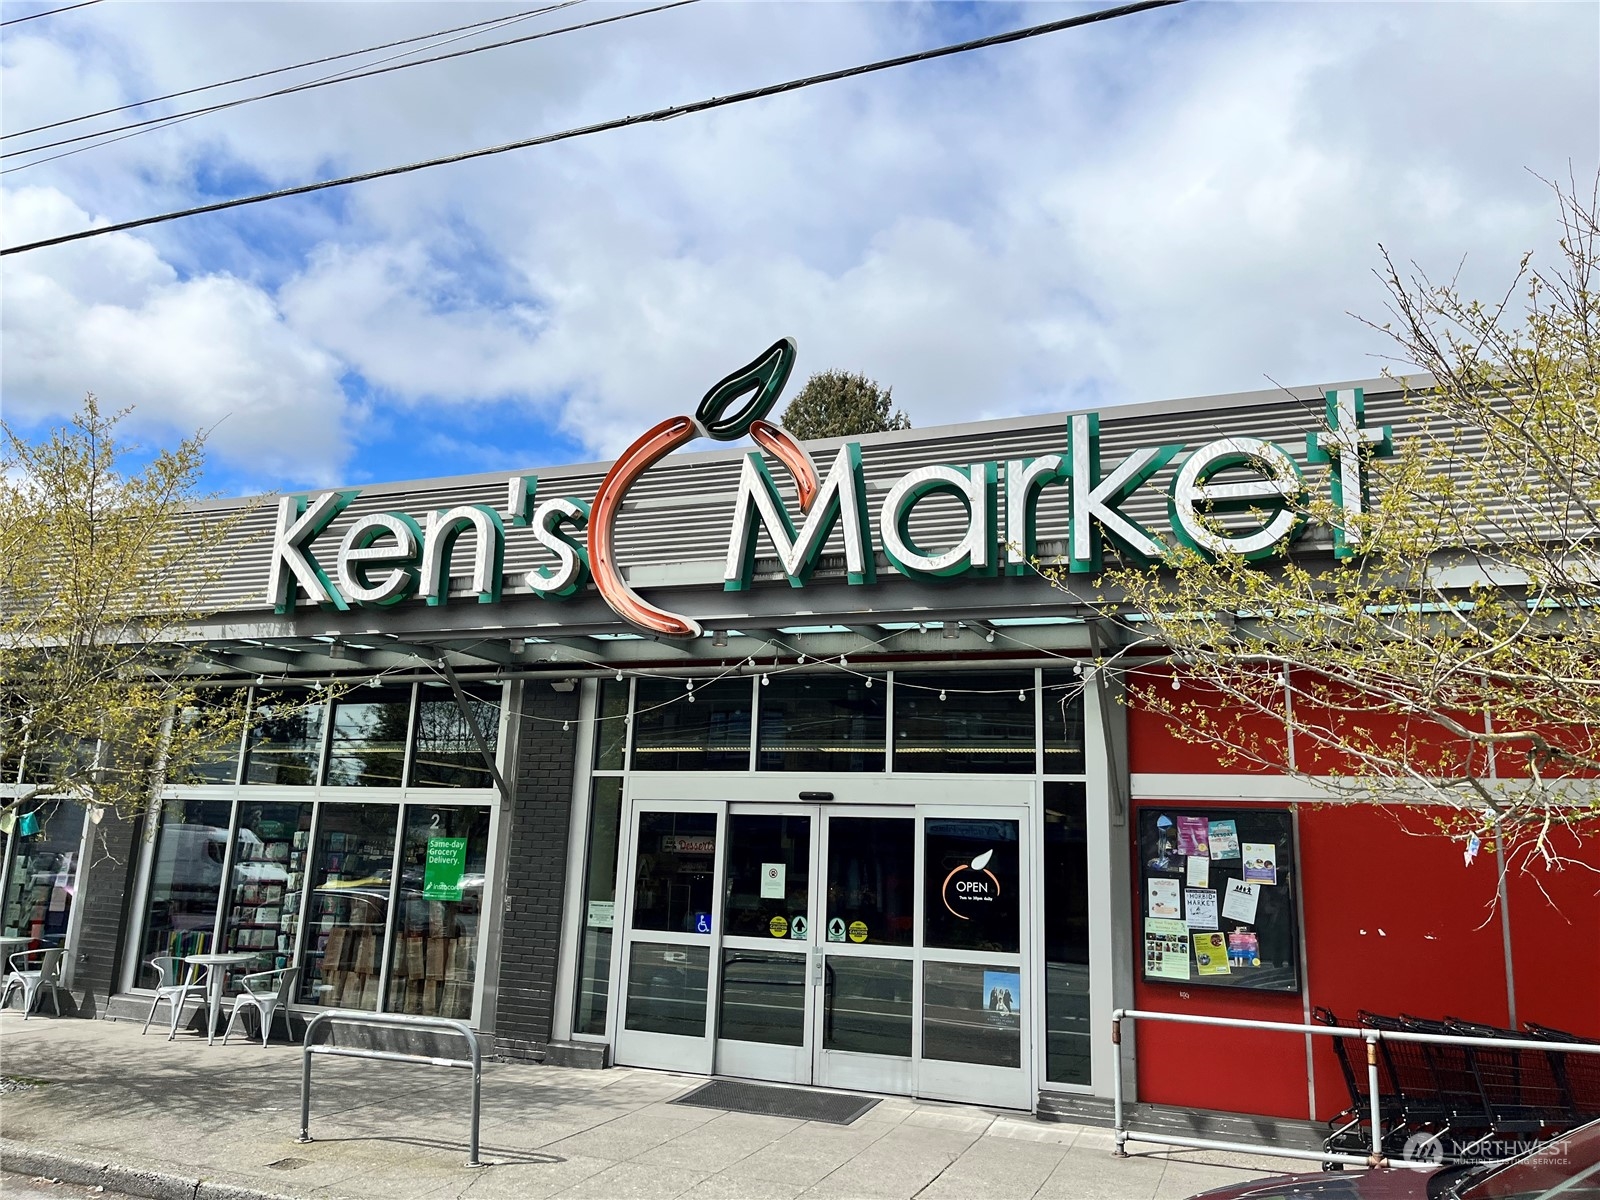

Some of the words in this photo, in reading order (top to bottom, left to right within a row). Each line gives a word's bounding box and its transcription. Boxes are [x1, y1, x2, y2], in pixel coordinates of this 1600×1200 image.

[267, 476, 590, 614] Ken's
[723, 388, 1392, 591] Market
[429, 813, 440, 829] 2
[430, 840, 465, 850] Same-day
[429, 848, 457, 857] Grocery
[428, 856, 460, 865] Delivery.
[956, 881, 988, 892] OPEN
